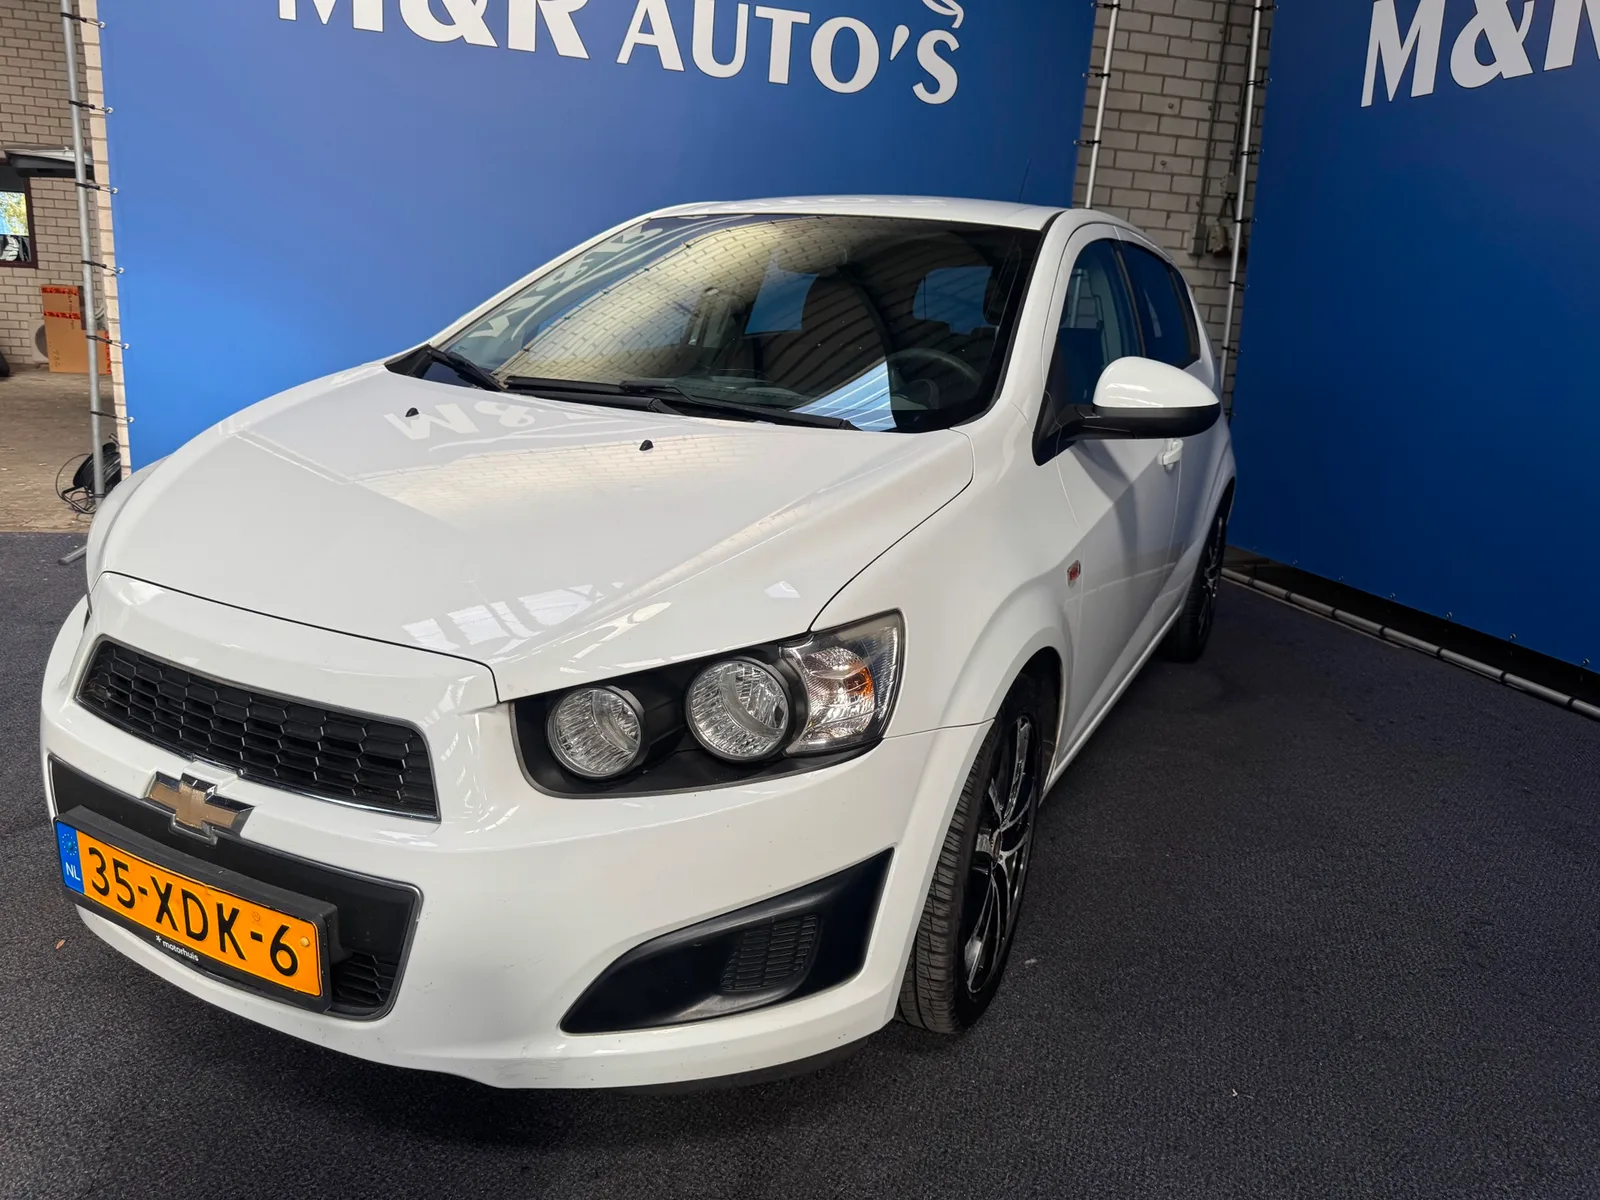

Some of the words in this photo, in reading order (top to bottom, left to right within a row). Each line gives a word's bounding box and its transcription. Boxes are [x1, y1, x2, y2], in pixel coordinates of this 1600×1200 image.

[615, 0, 961, 105] AUTO'S
[65, 861, 81, 881] NL
[88, 846, 299, 977] 35-XDK-6
[162, 940, 199, 962] motorhuis
